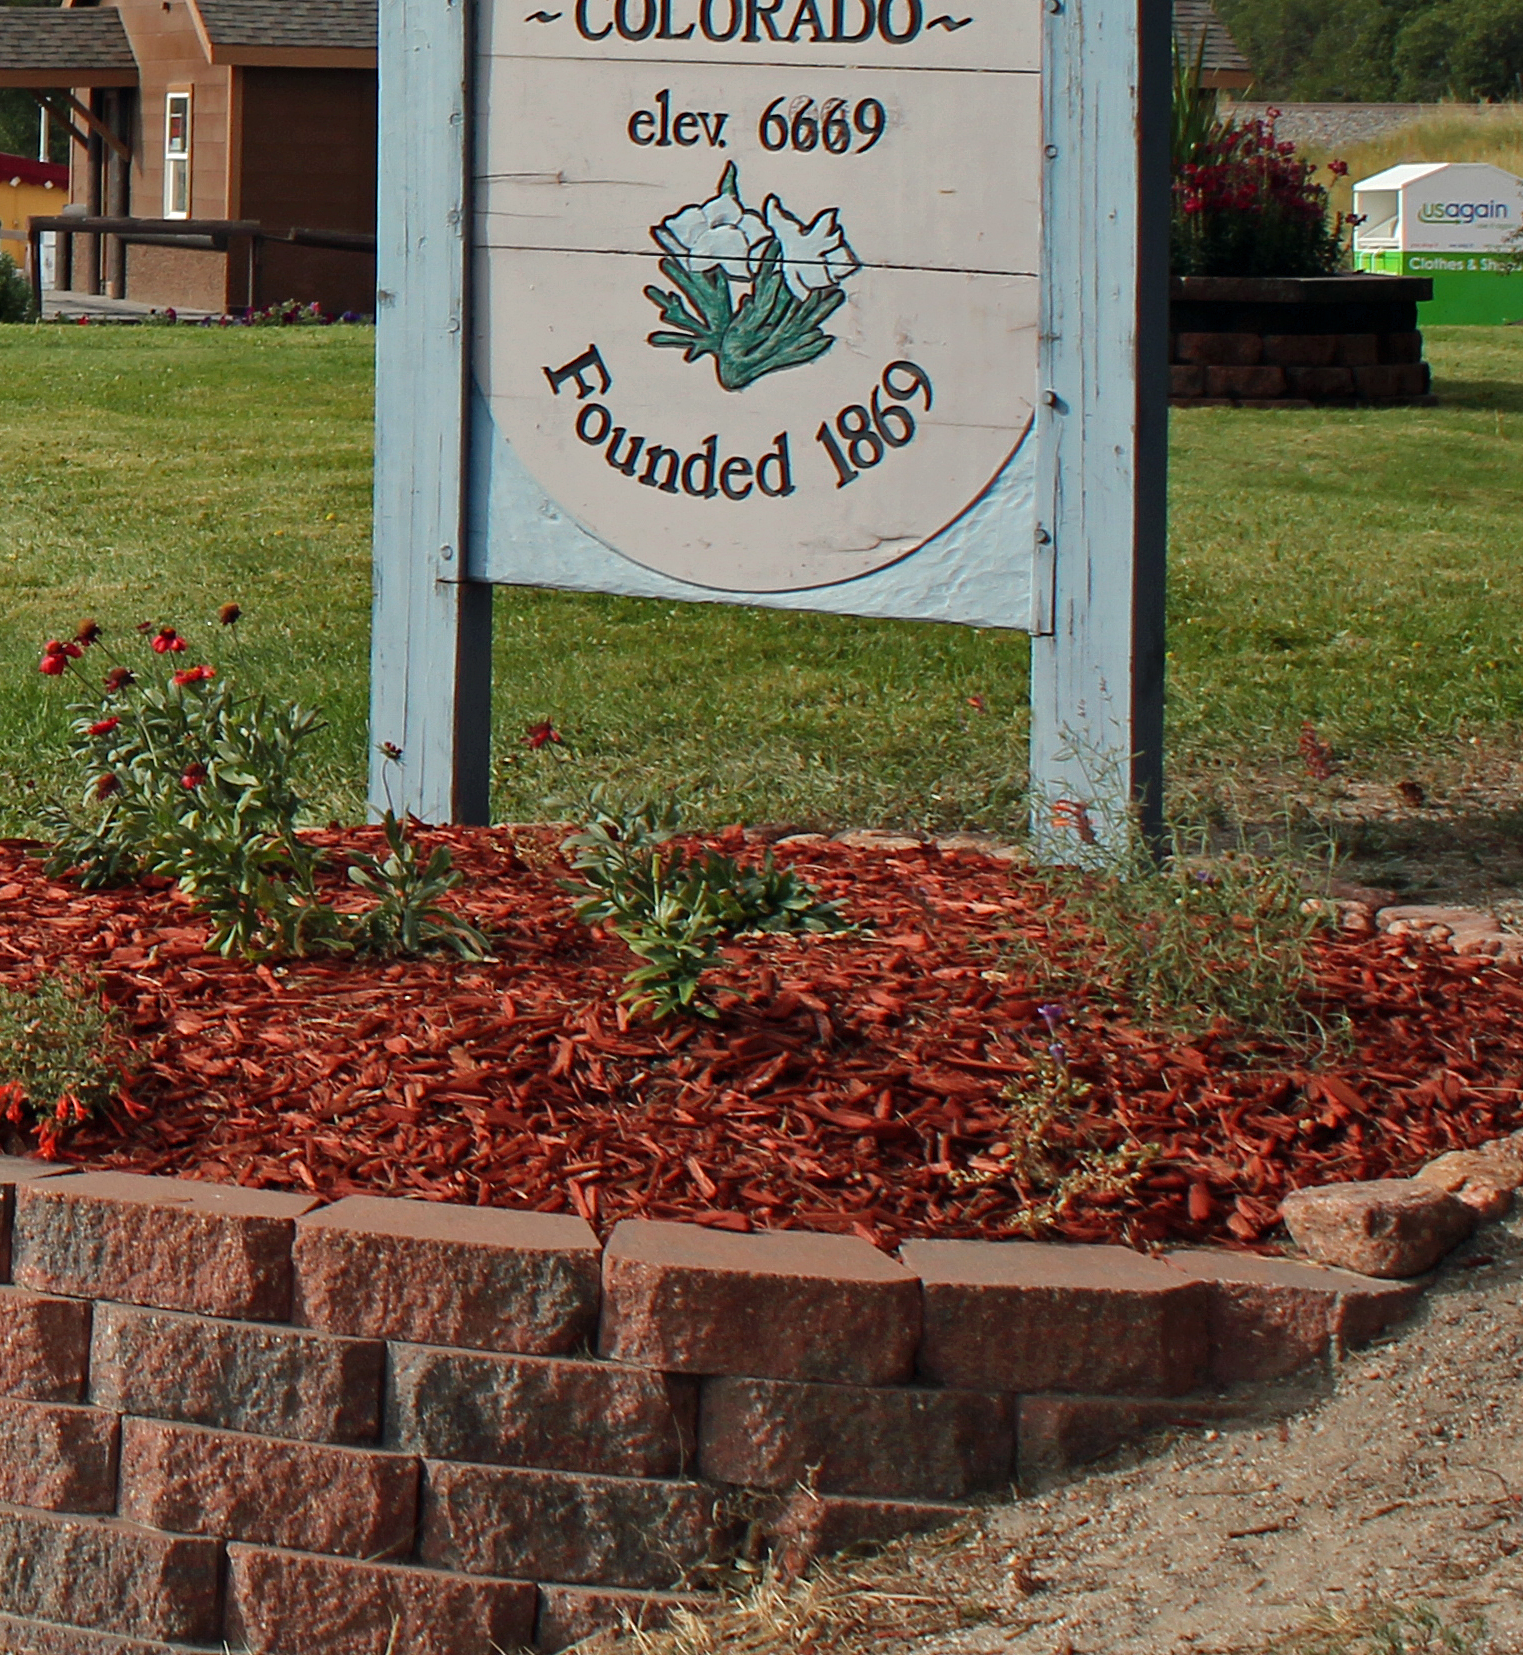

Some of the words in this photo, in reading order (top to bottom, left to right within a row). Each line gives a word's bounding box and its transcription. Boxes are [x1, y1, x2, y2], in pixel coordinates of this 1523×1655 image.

[627, 88, 729, 148] elev.
[758, 96, 886, 154] 6669
[1421, 199, 1507, 224] usagain
[1409, 257, 1464, 270] Clothes
[541, 344, 795, 501] Founded
[816, 359, 934, 489] 1869
